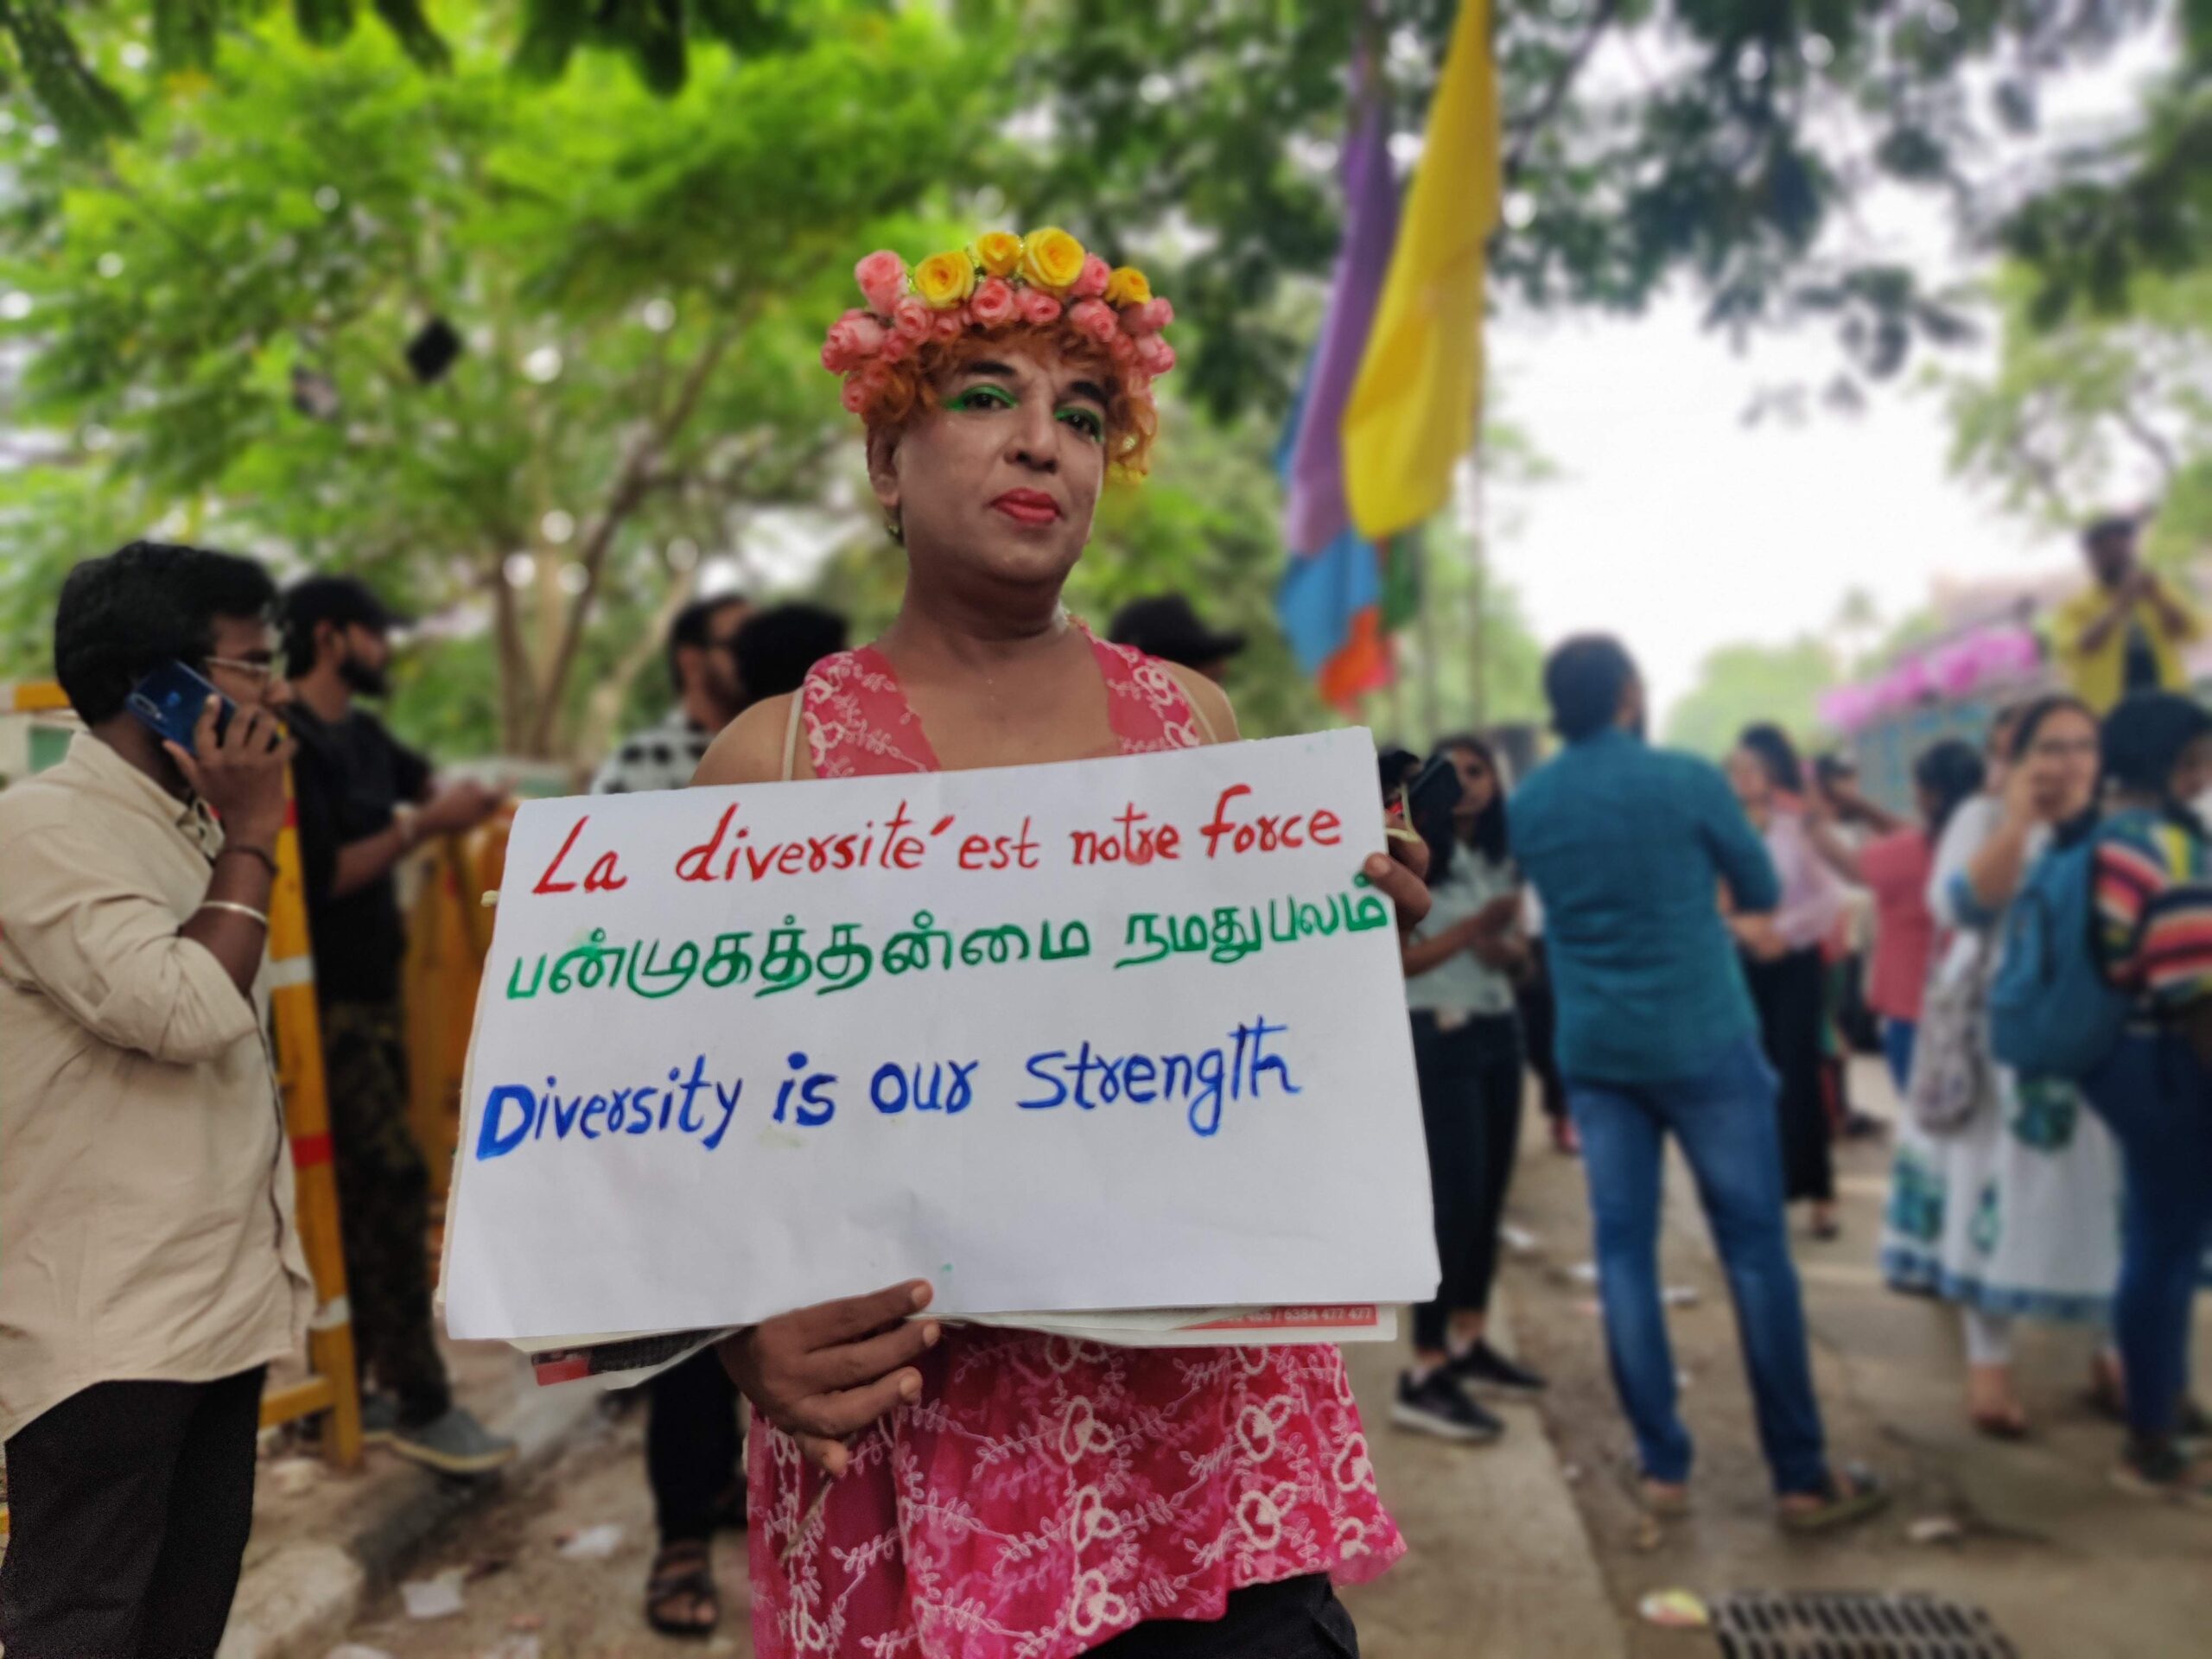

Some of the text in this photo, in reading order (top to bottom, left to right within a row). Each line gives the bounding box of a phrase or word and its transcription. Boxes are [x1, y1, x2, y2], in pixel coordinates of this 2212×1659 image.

[531, 783, 1342, 894] La diversité est notre force
[505, 909, 1092, 1001] பன்முகத்தன்மை
[474, 1053, 744, 1163] Diversity
[772, 1052, 837, 1128] is
[869, 1060, 980, 1116] our
